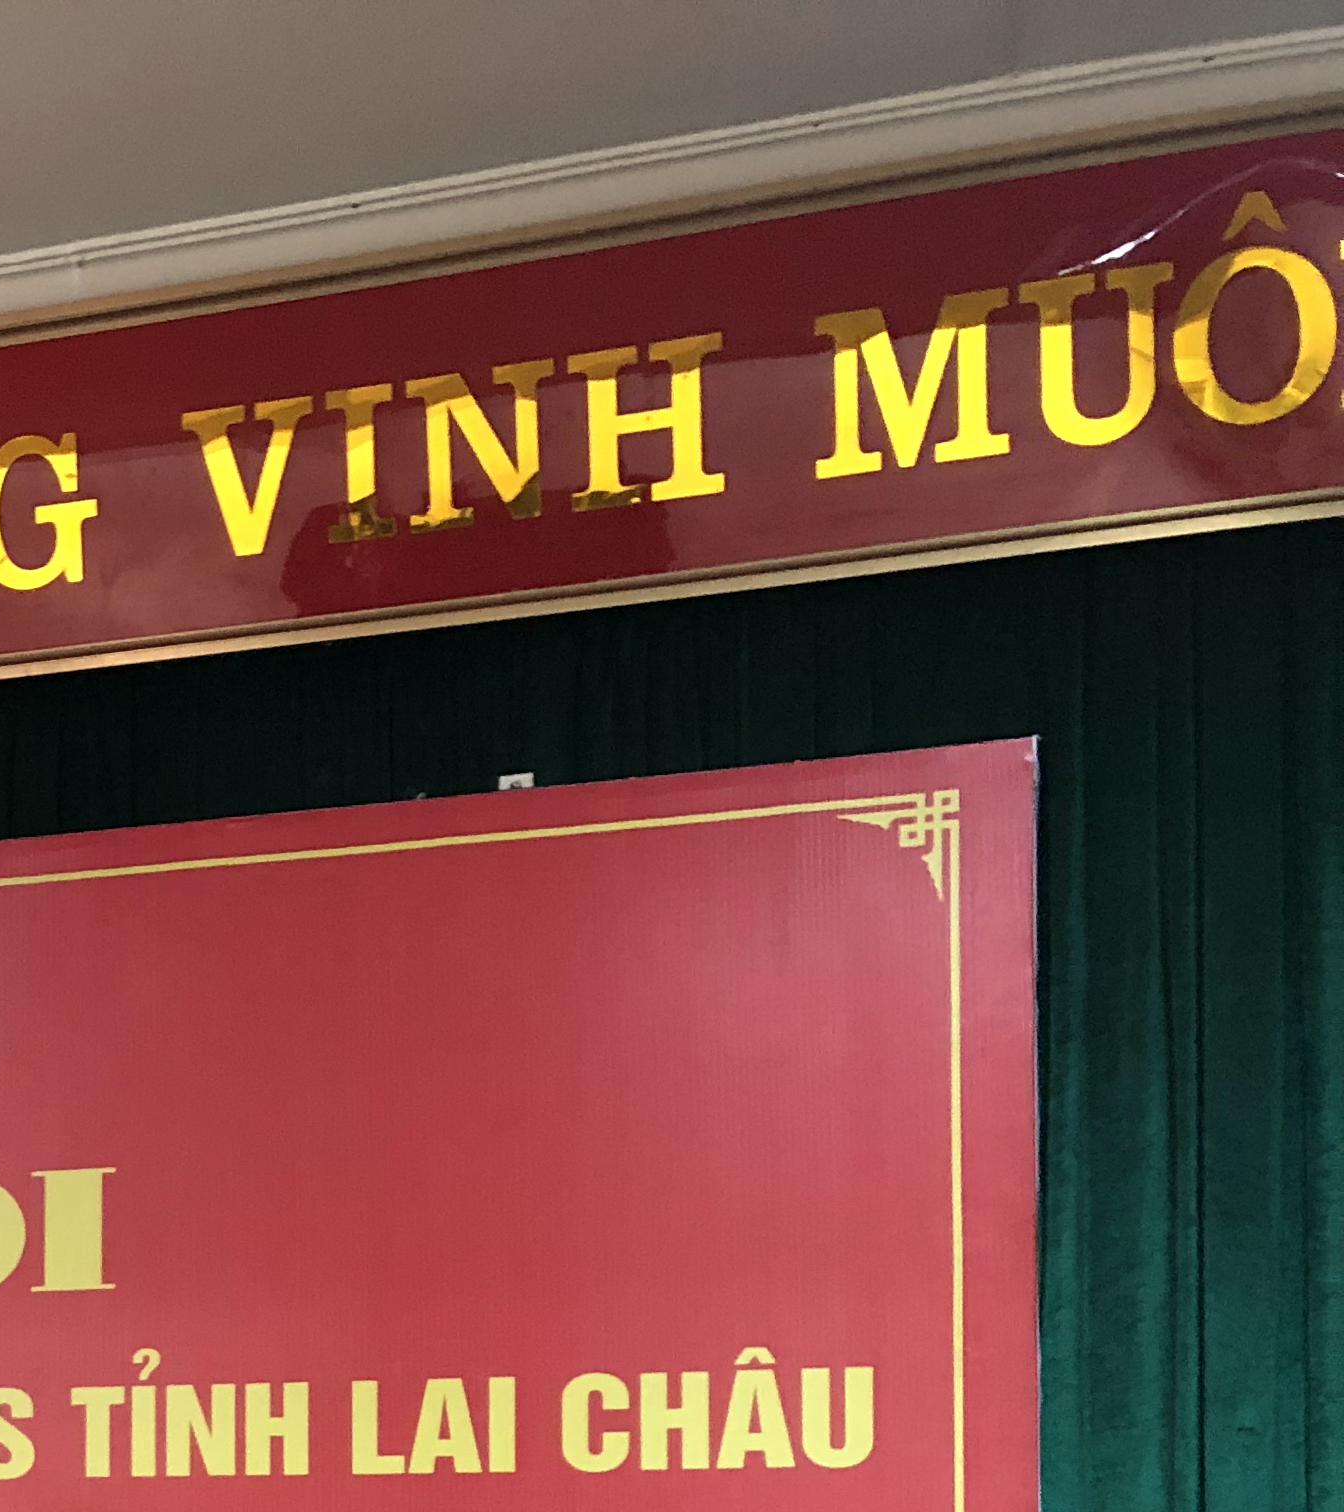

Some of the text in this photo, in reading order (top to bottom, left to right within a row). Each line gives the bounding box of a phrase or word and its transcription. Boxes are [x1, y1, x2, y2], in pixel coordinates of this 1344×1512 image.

[182, 333, 726, 558] VINH
[815, 192, 1344, 480] MUÔ
[70, 1348, 310, 1478] TỈNH
[352, 1377, 516, 1476] LAI
[561, 1347, 875, 1473] CHÂU
